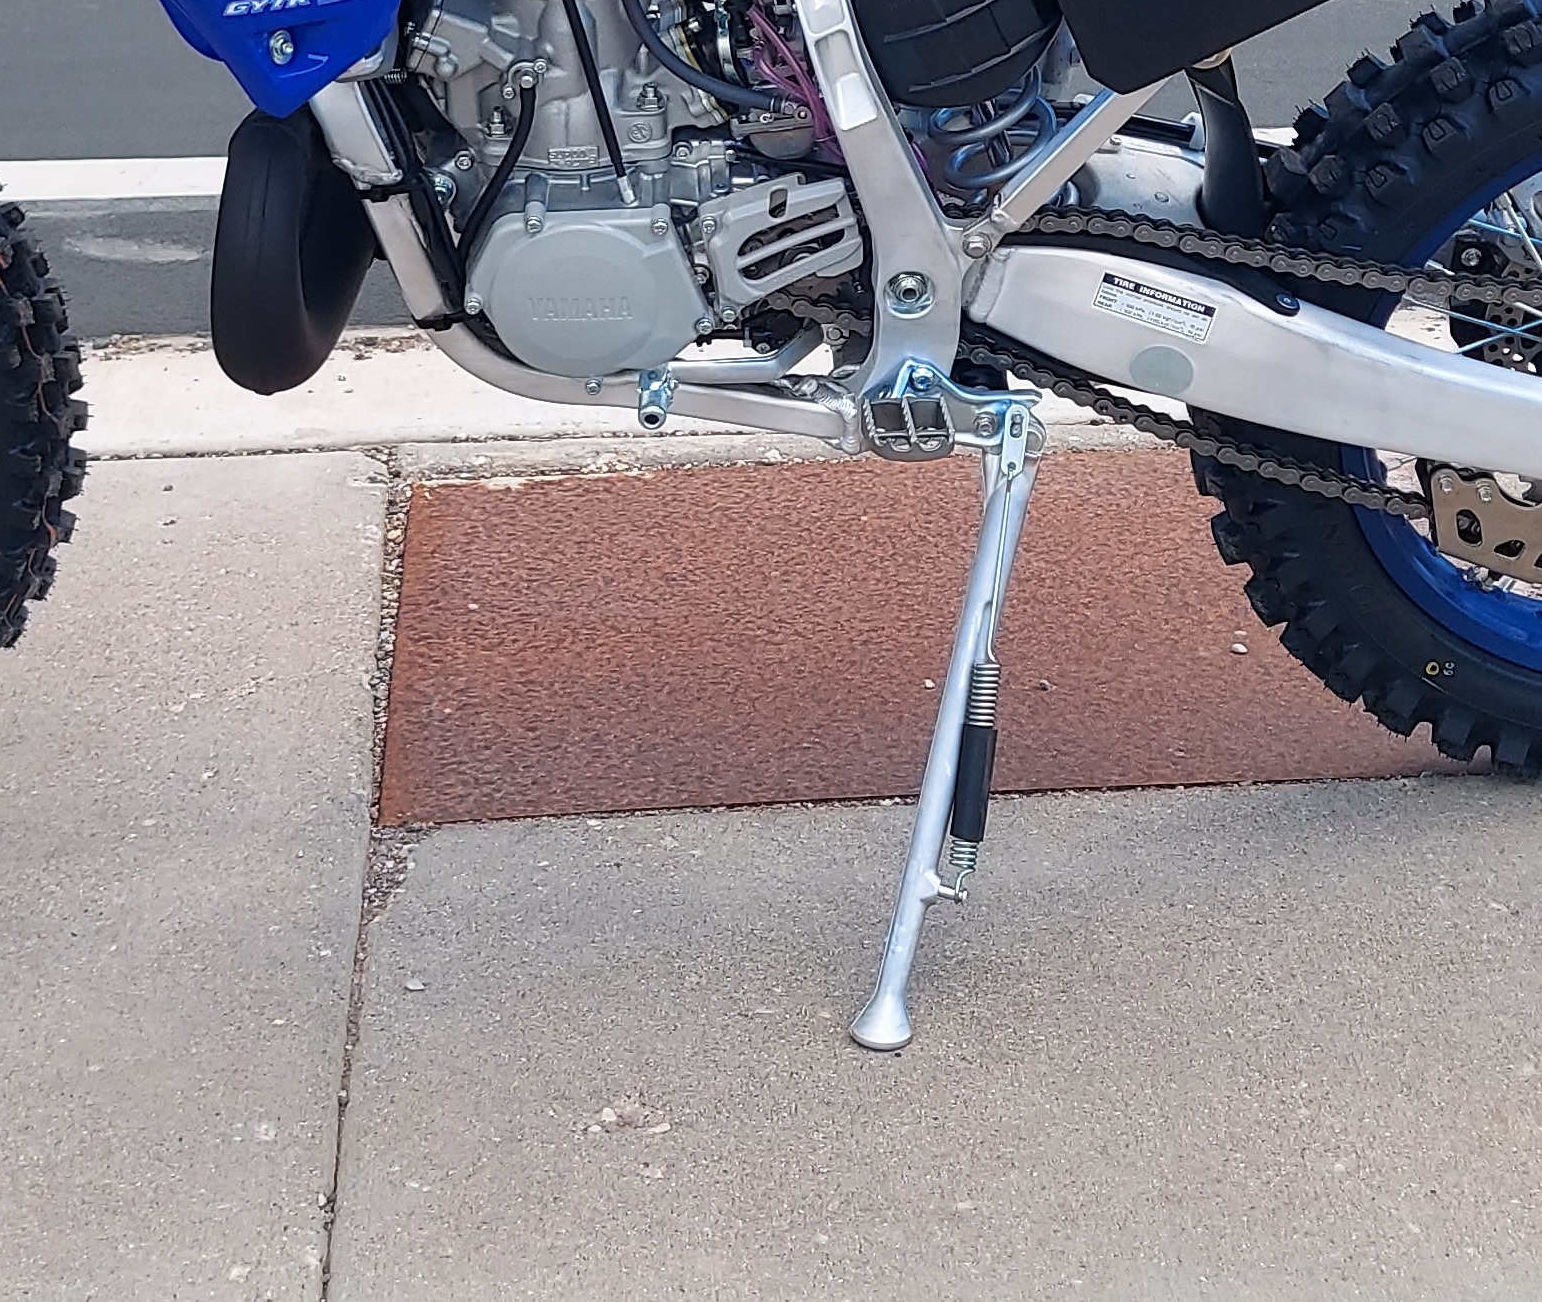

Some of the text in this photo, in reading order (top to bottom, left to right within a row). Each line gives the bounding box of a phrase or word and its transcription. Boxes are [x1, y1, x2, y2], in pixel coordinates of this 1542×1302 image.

[528, 297, 634, 321] YAMAHA
[1113, 277, 1136, 290] TIRE
[1139, 285, 1206, 314] INFORMATION
